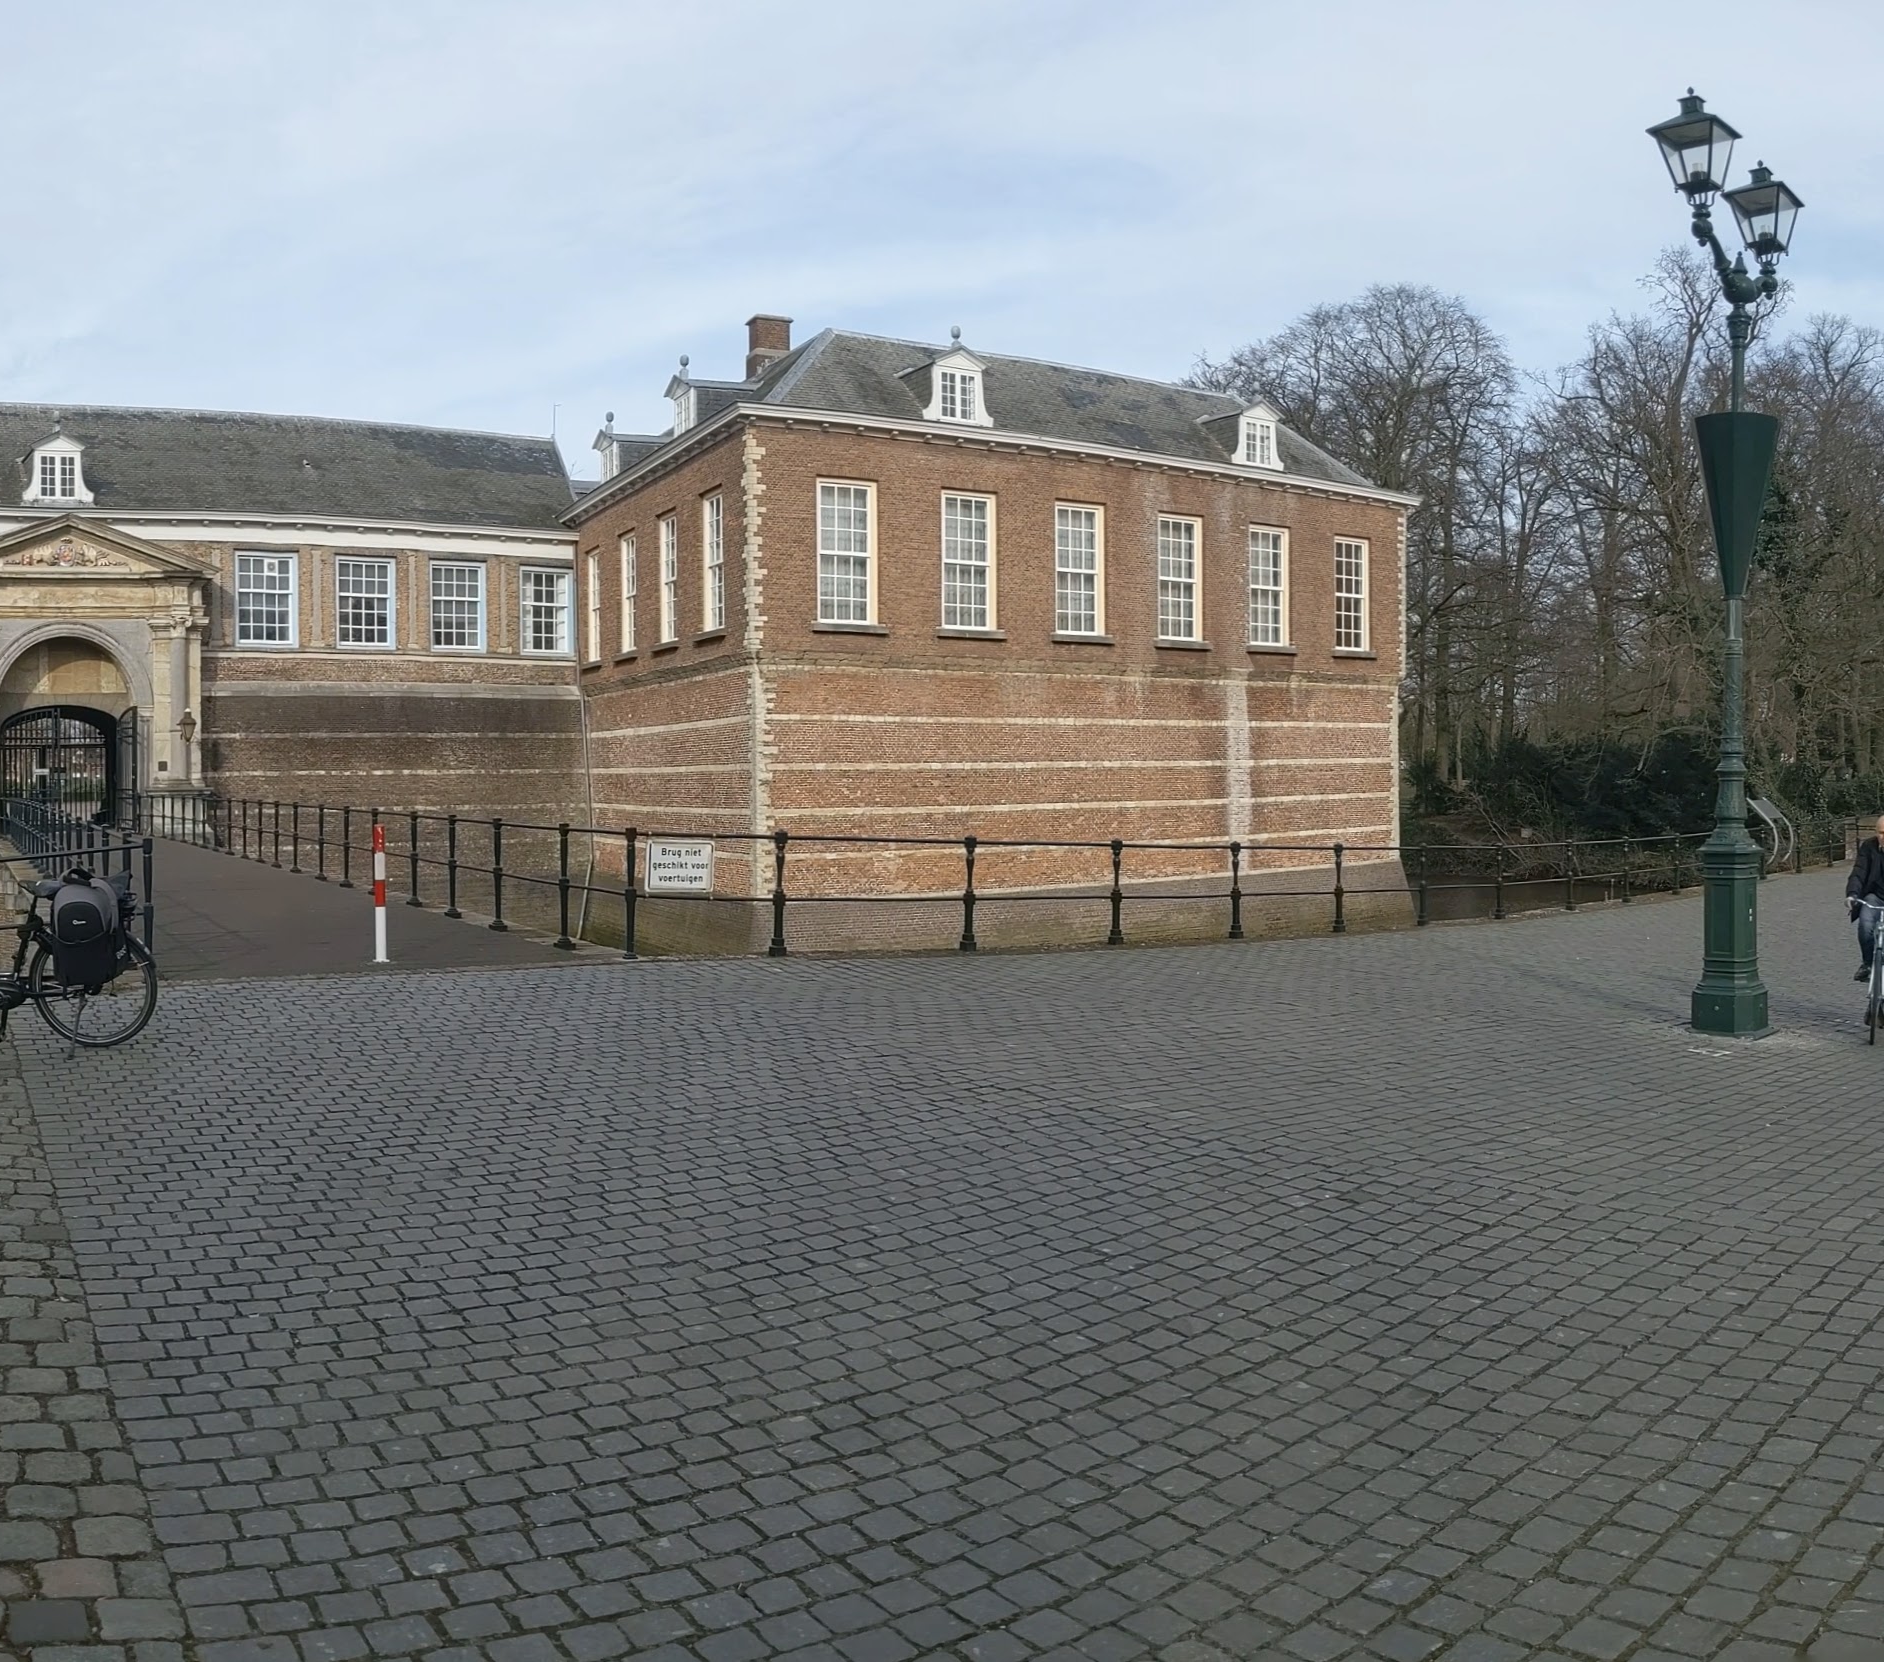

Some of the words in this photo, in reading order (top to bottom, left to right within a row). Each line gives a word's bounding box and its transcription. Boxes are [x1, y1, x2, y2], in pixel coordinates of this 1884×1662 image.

[661, 847, 682, 858] Brug
[685, 848, 702, 857] niet
[652, 861, 688, 870] geschikt
[658, 874, 703, 884] voertuigen
